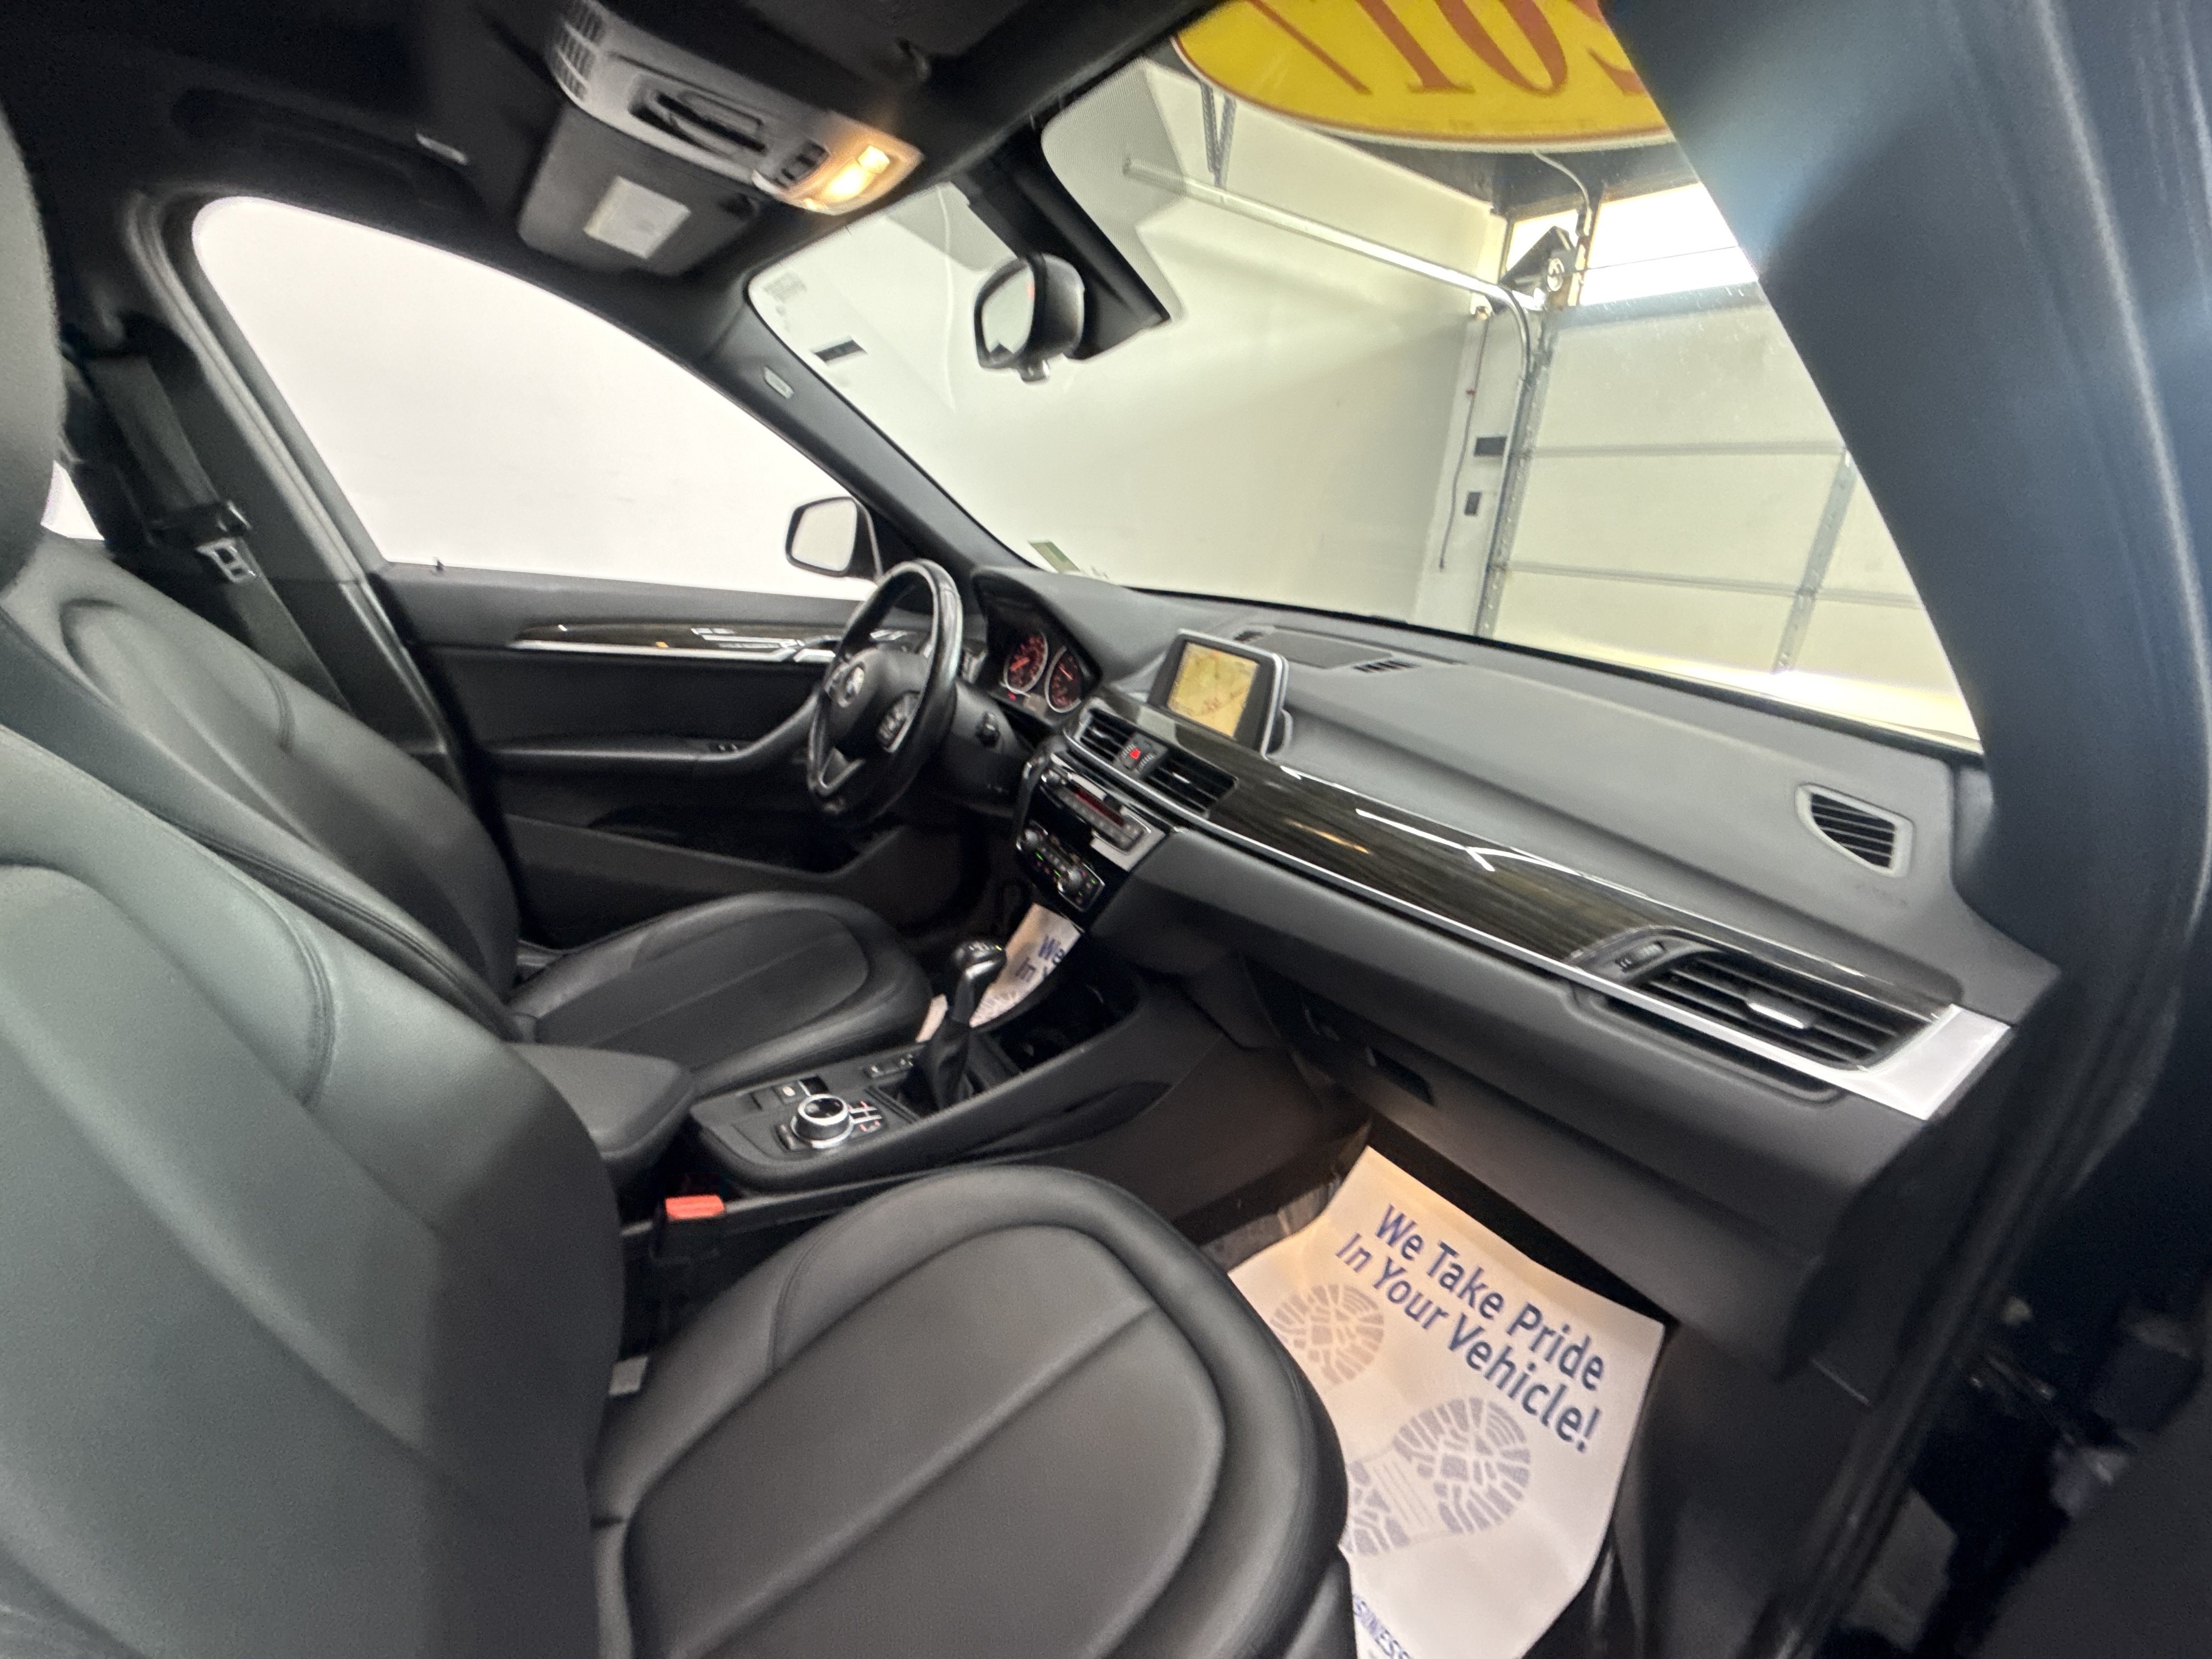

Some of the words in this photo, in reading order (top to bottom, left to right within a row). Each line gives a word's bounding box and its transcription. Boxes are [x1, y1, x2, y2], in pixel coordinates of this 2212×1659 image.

[1335, 1233, 1372, 1273] In
[1372, 1257, 1448, 1330] Your
[1447, 1314, 1602, 1453] Vehicle!
[1375, 1204, 1425, 1261] We
[1426, 1242, 1505, 1319] Take
[1510, 1302, 1604, 1391] Pride
